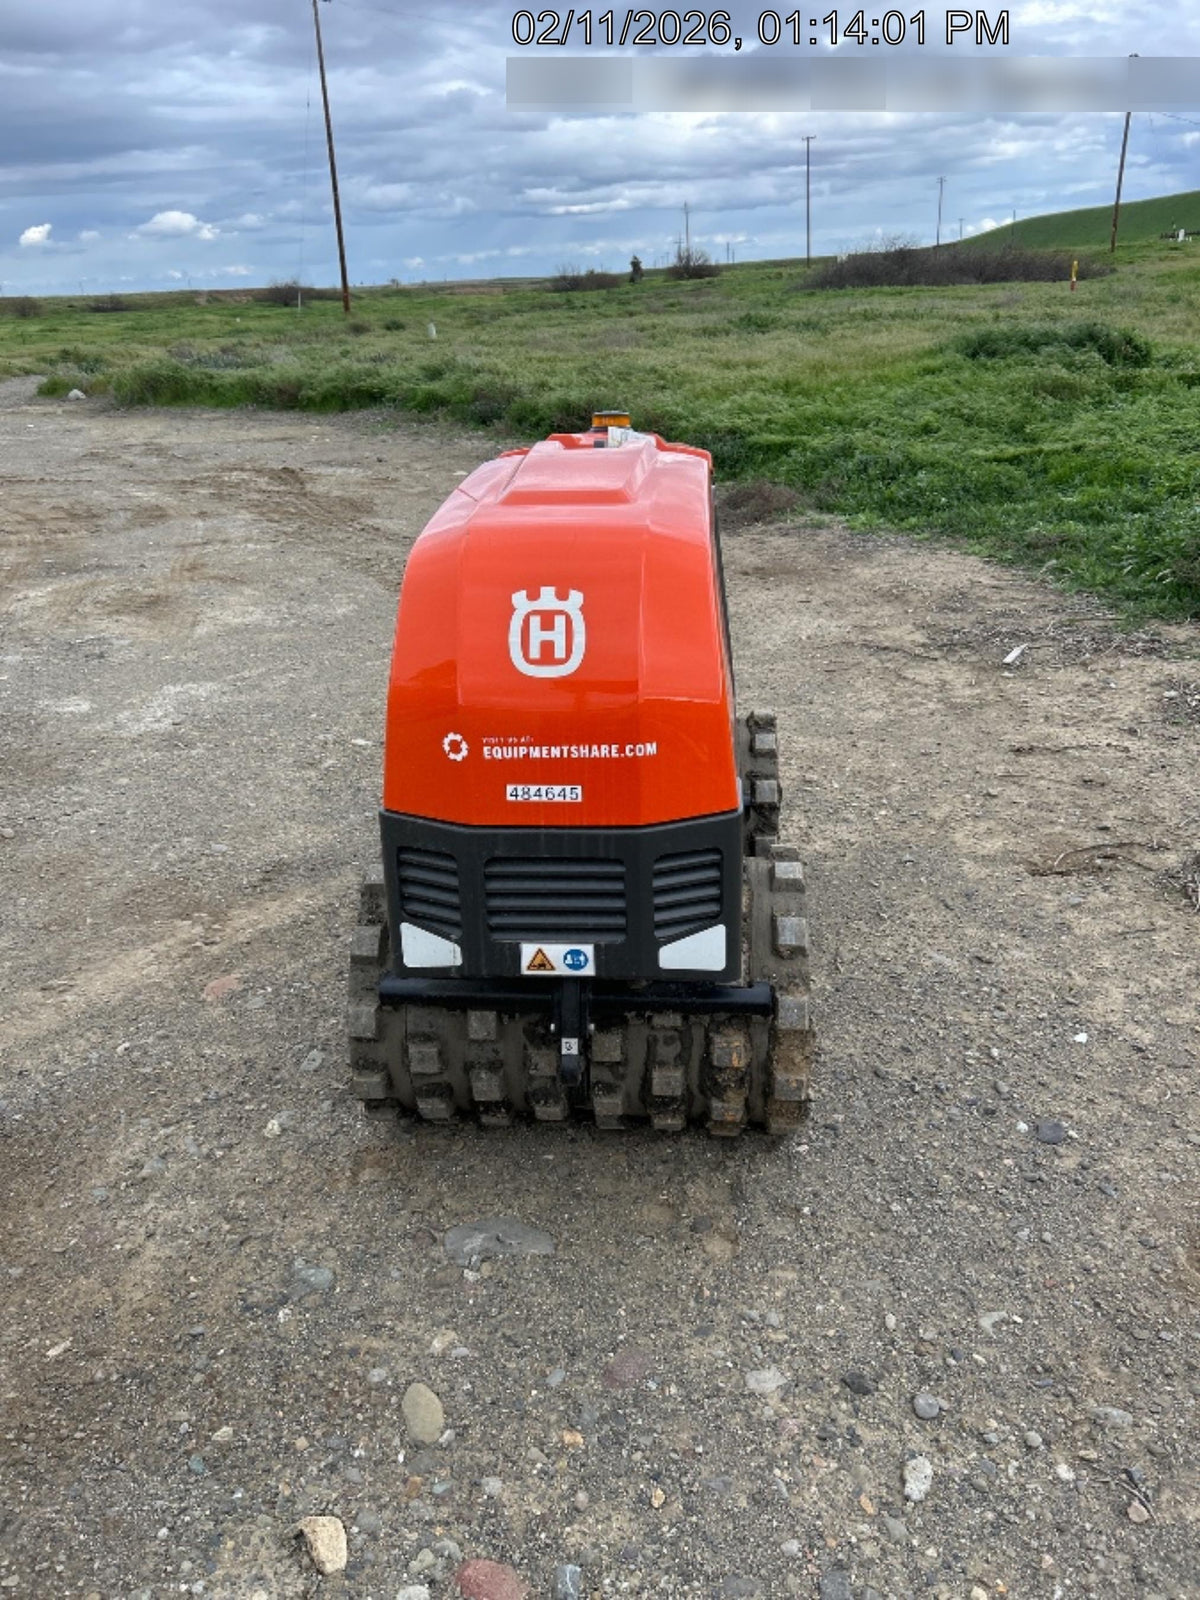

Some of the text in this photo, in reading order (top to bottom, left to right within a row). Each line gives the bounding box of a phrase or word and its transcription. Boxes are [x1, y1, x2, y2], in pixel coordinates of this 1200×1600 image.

[529, 614, 566, 659] H
[483, 742, 658, 760] EQUIPMENTSHARE.COM
[509, 786, 579, 801] 484645
